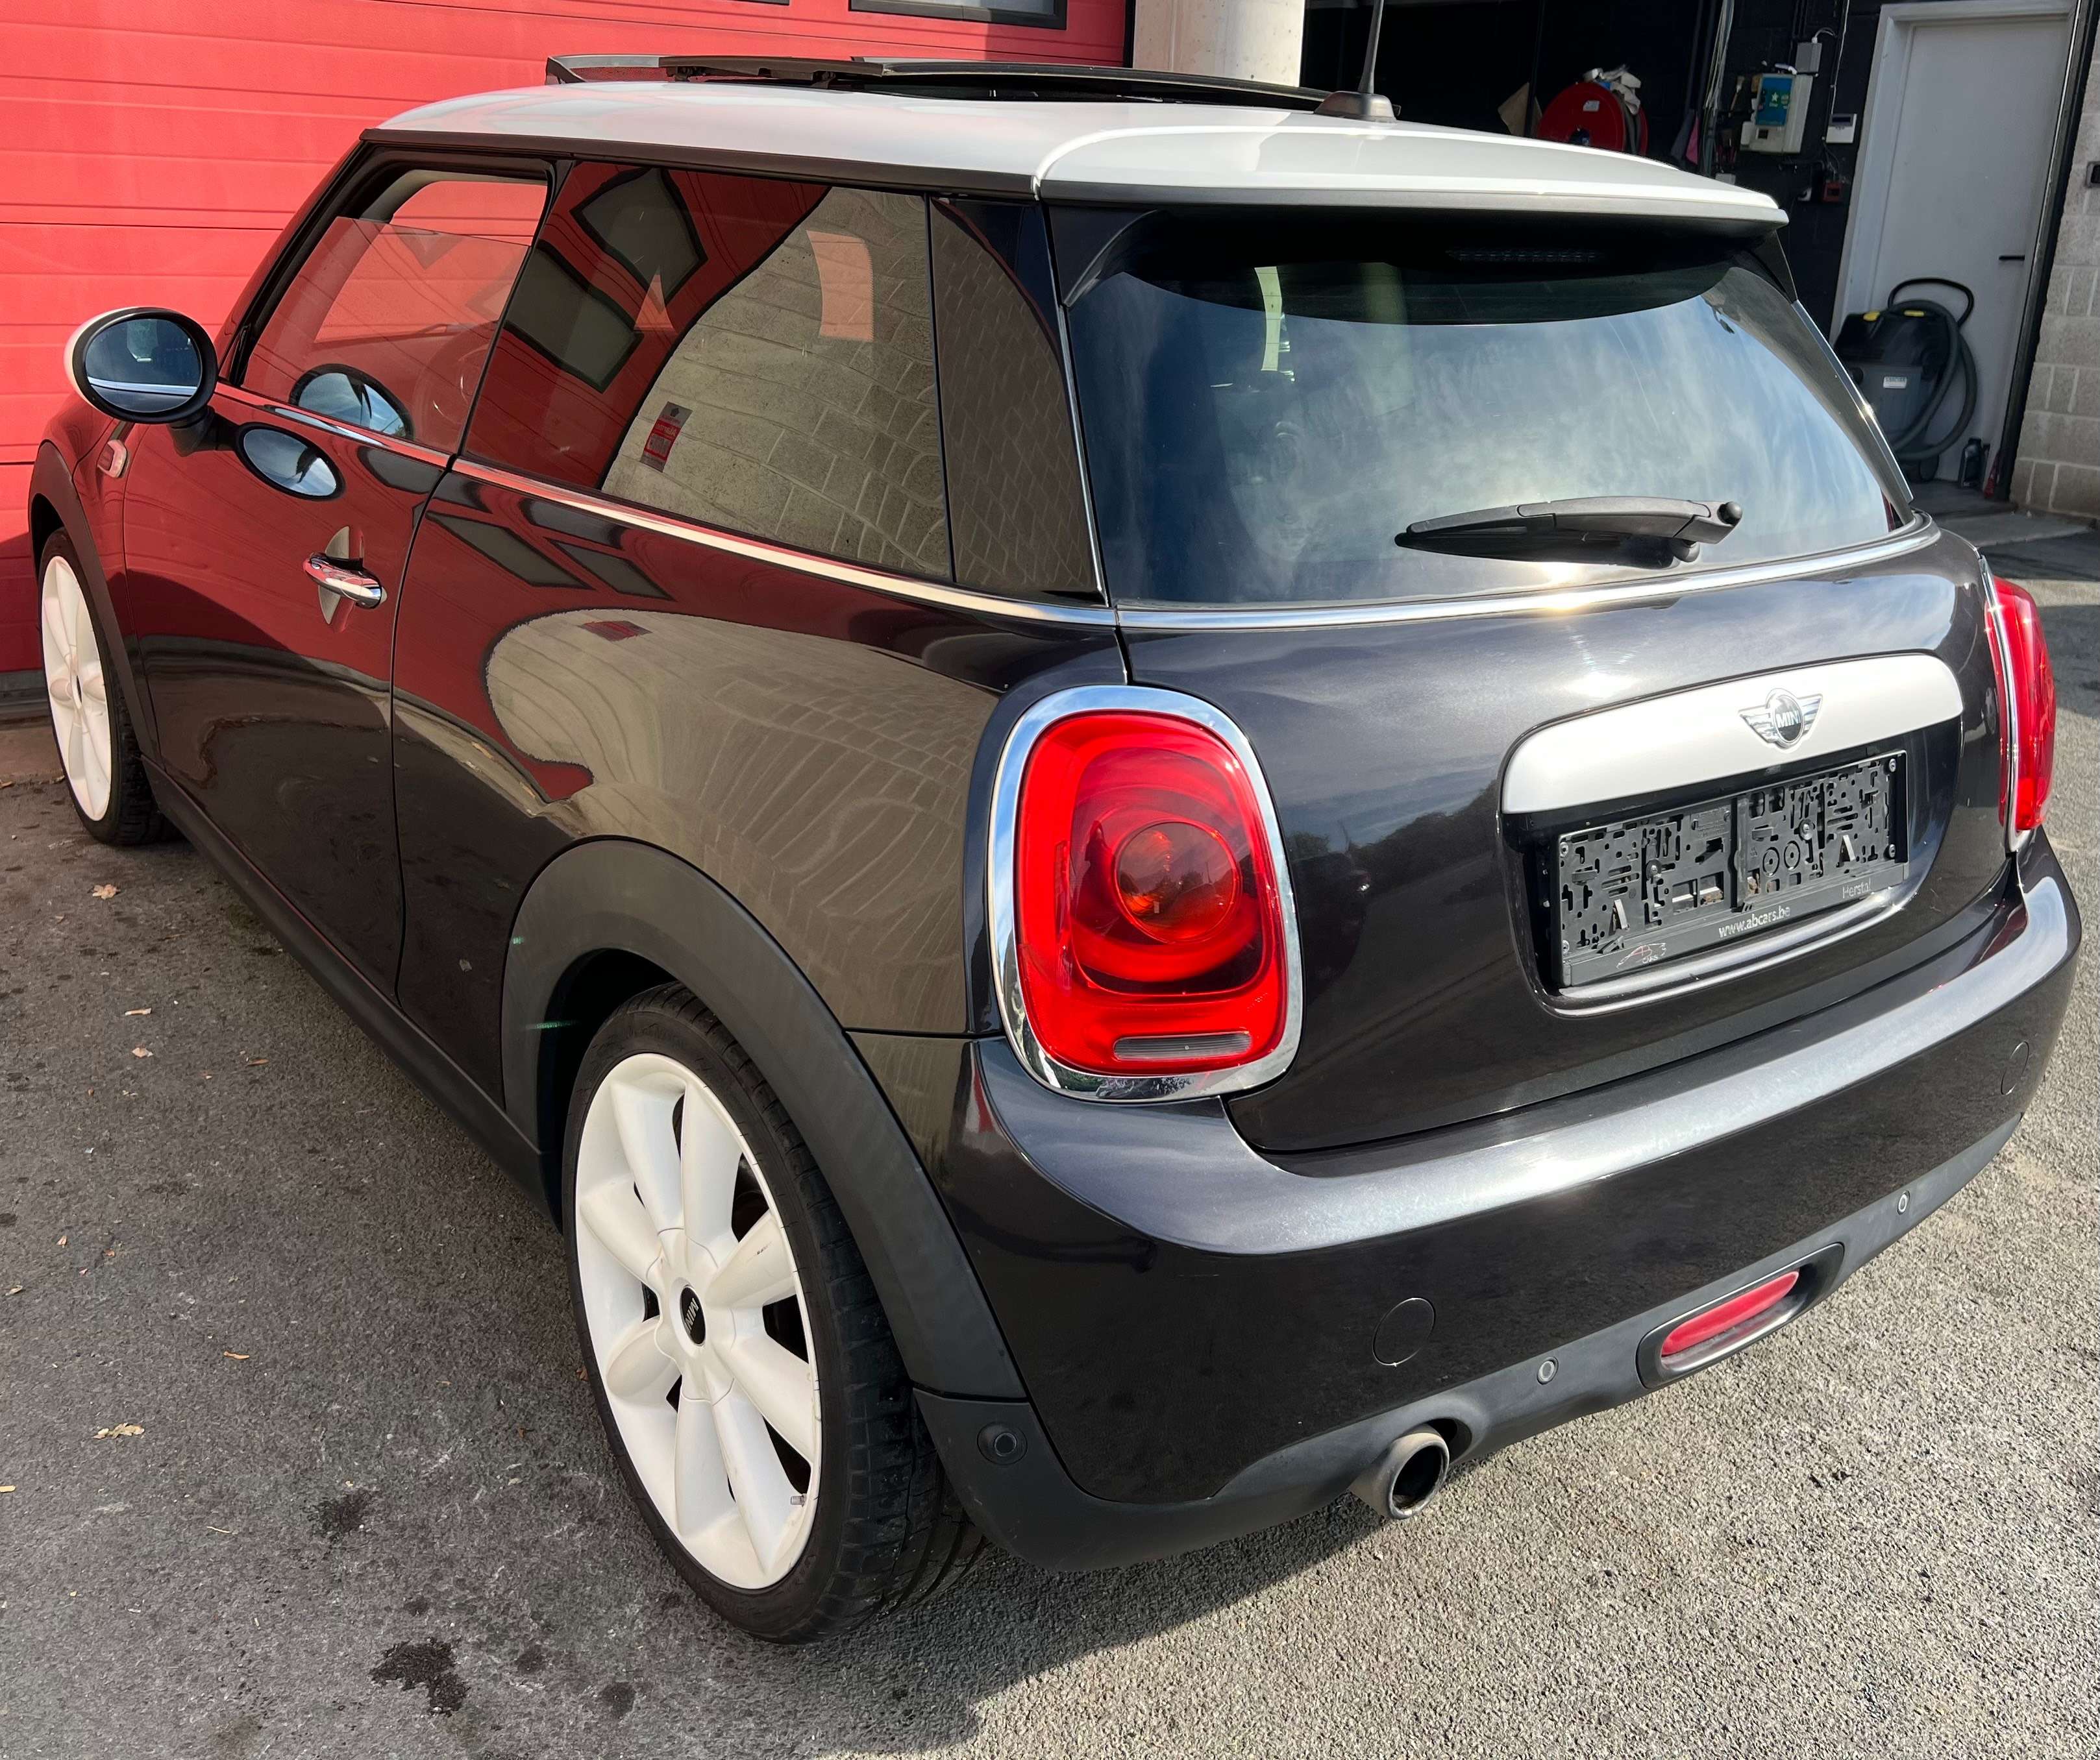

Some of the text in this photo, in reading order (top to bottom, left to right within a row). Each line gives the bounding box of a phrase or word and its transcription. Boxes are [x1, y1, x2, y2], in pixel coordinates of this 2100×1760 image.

[1775, 710, 1801, 728] MINI
[1718, 905, 1790, 938] www.abcars.be
[685, 1297, 699, 1334] MINI
